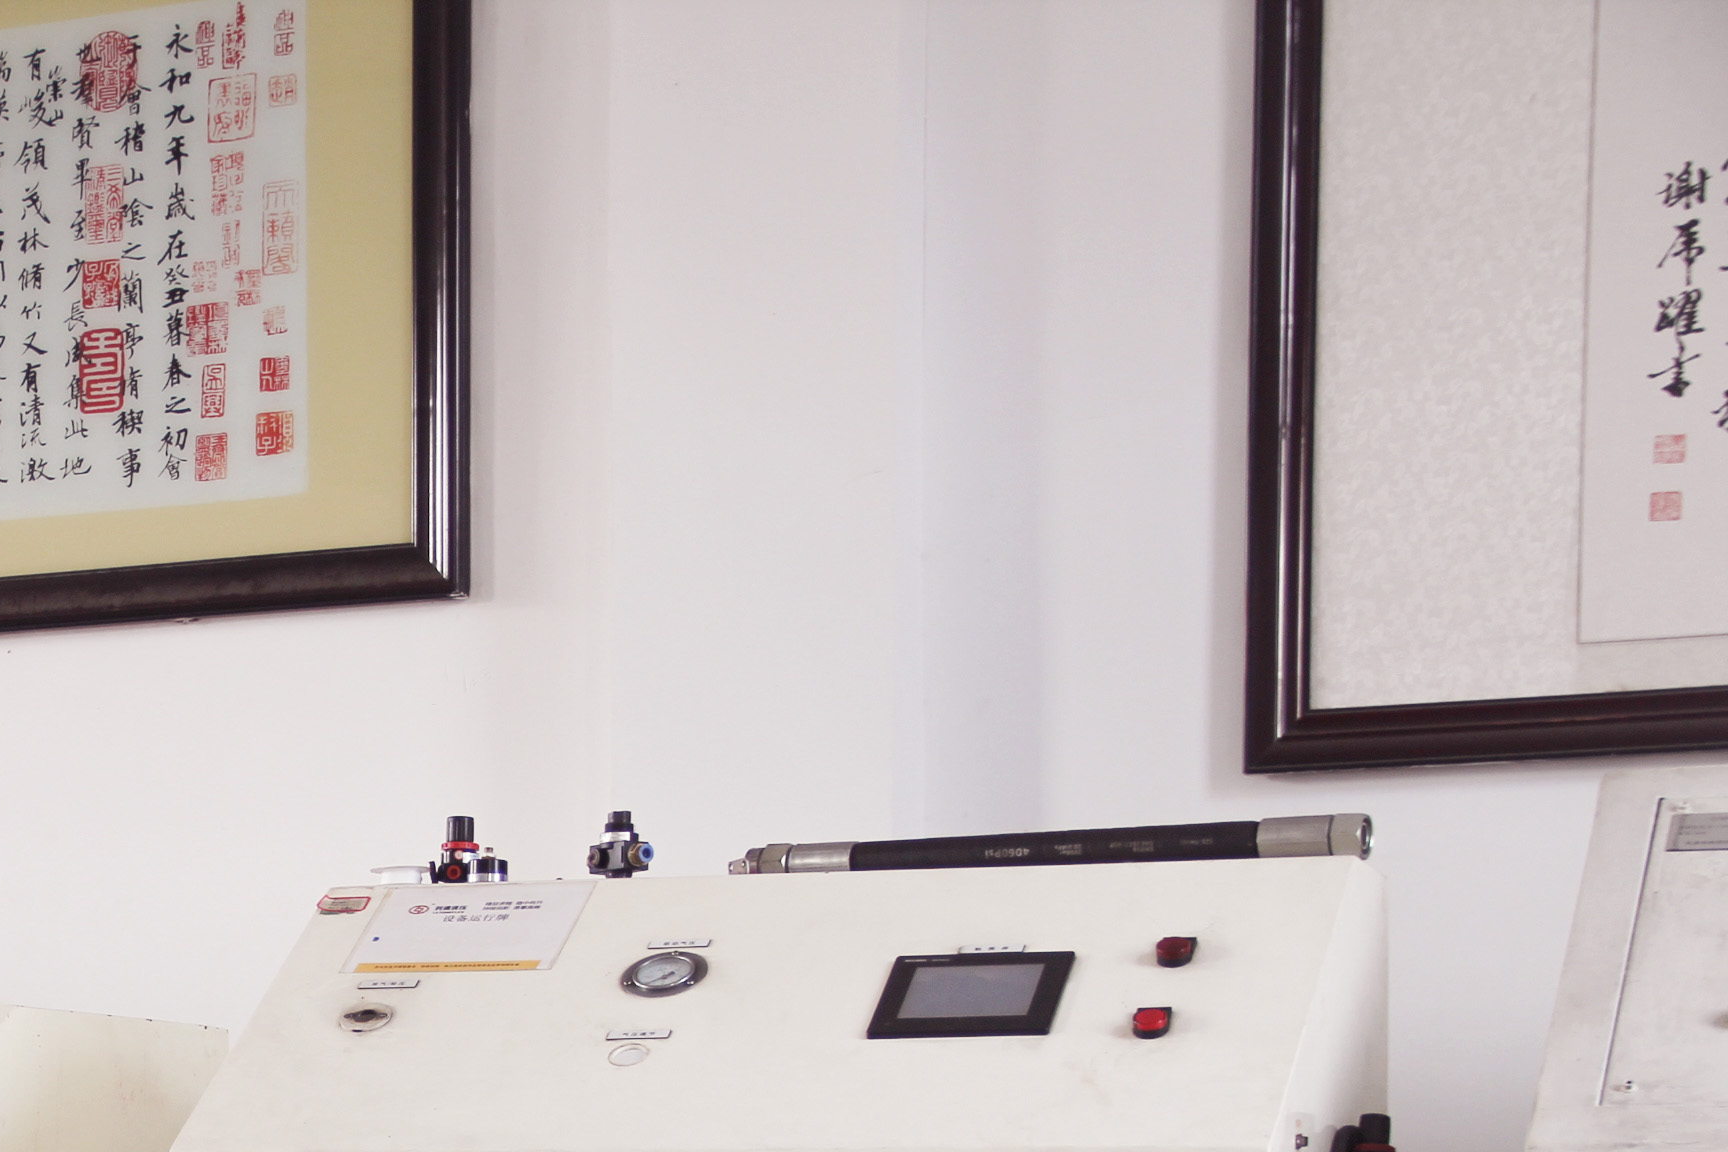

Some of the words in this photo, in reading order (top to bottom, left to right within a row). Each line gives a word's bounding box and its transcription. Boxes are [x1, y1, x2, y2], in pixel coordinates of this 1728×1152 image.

[442, 913, 510, 923] 设备运行牌
